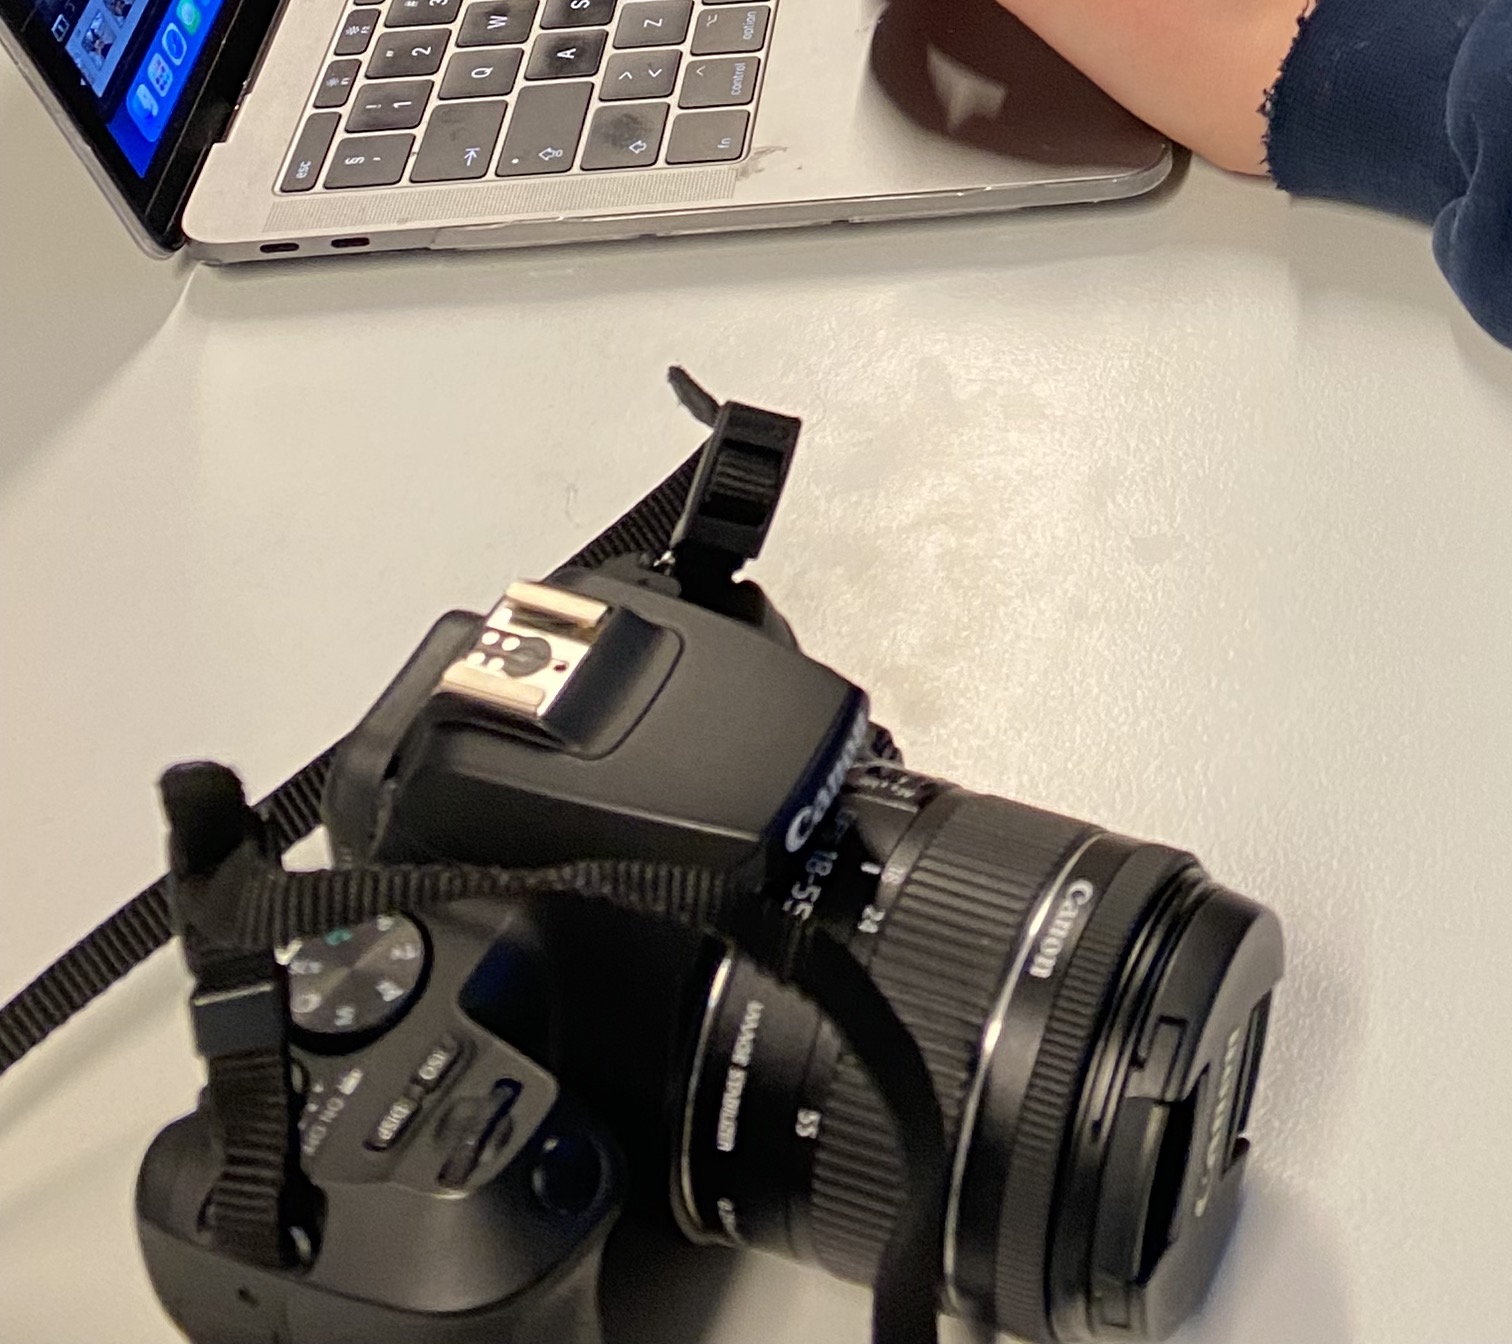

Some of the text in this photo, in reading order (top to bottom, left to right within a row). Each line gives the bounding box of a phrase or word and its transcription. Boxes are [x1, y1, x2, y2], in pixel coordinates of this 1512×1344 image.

[570, 0, 590, 9] S
[487, 15, 508, 29] W
[644, 19, 663, 28] Z
[743, 10, 757, 41] option
[412, 46, 432, 56] 2
[557, 47, 577, 59] A
[471, 67, 494, 78] Q
[730, 62, 746, 96] control
[717, 137, 731, 149] fn
[296, 160, 312, 180] esc
[1028, 879, 1094, 978] Canon
